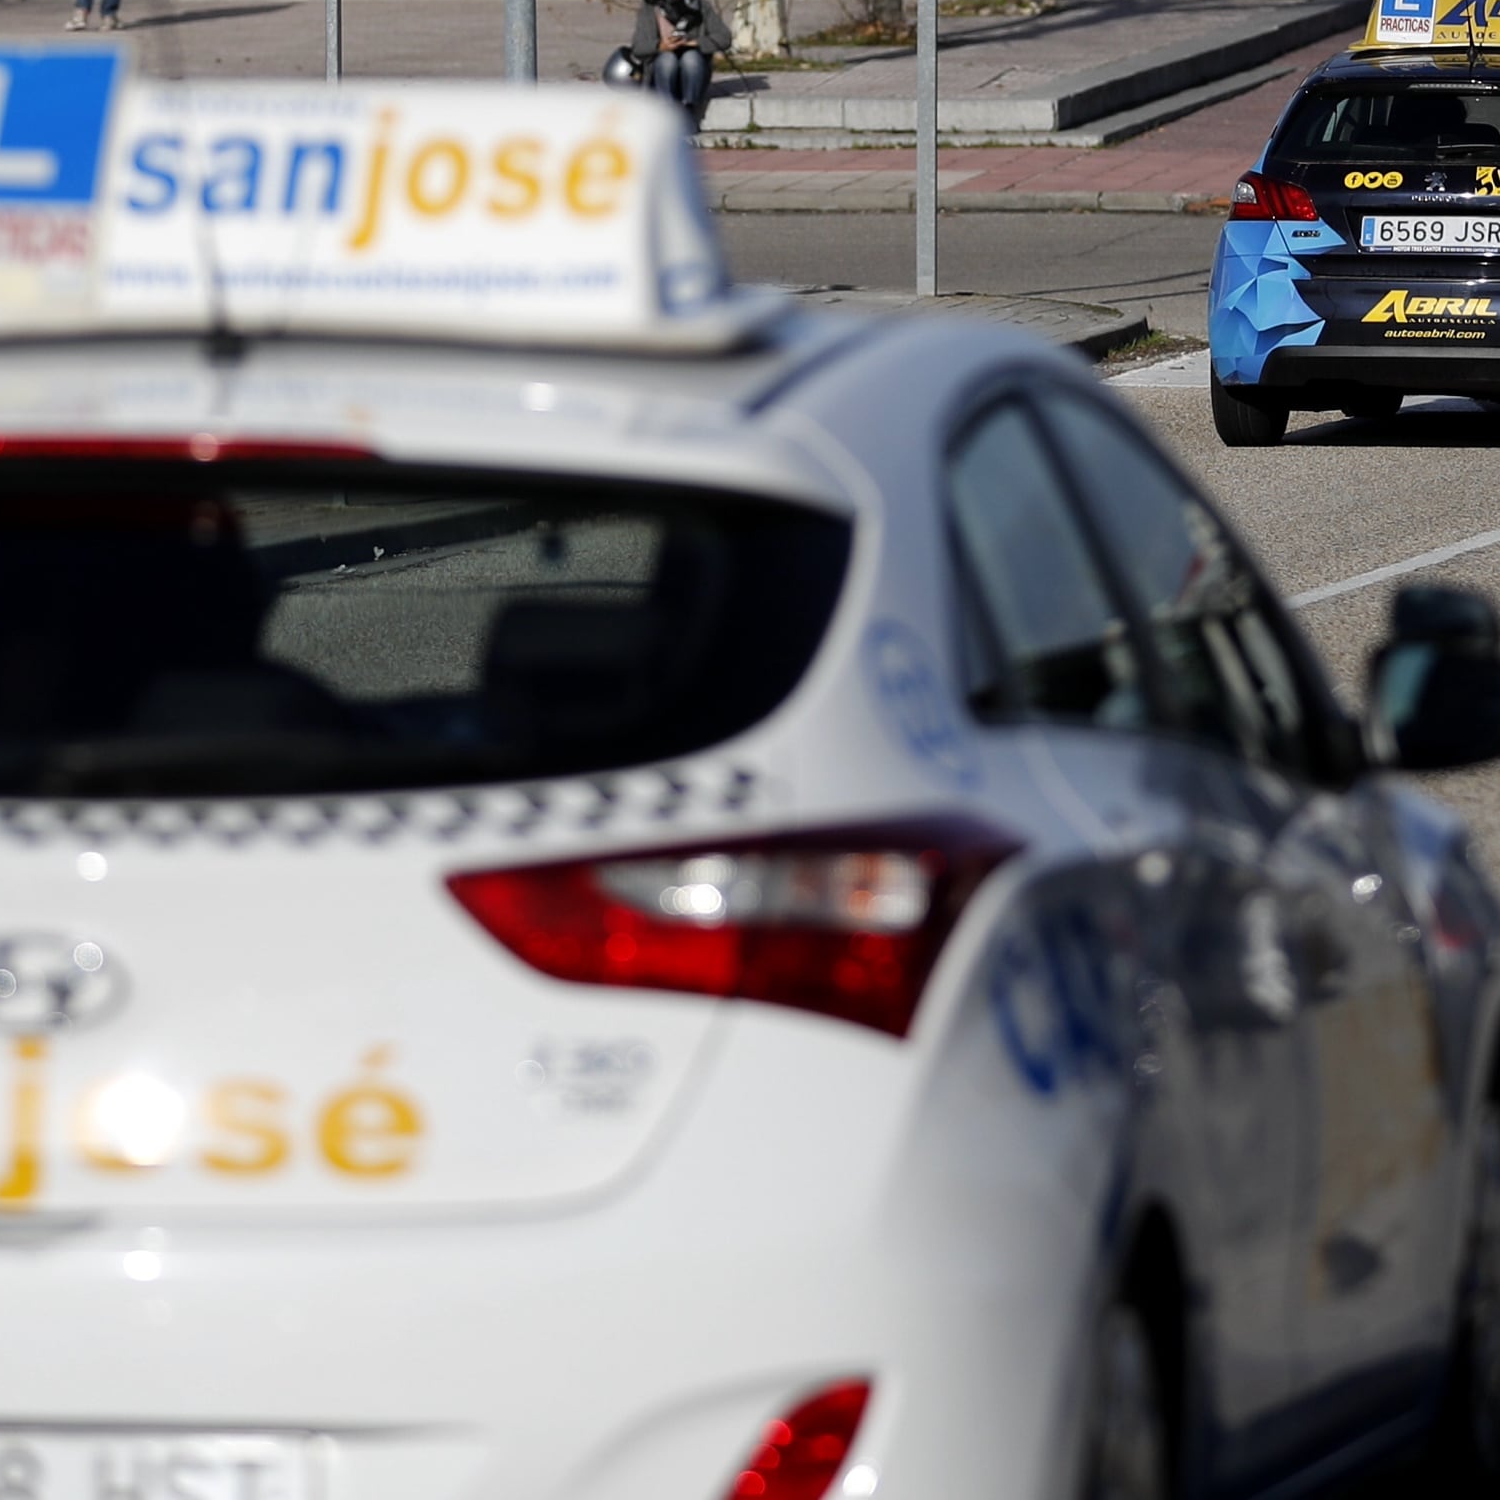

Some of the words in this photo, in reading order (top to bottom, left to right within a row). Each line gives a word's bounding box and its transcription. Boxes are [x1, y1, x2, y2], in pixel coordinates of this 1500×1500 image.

[1380, 17, 1431, 33] PRACTICAS
[122, 104, 634, 254] sanjosé
[1379, 220, 1444, 243] 6569
[1384, 328, 1486, 340] autoeabril.com
